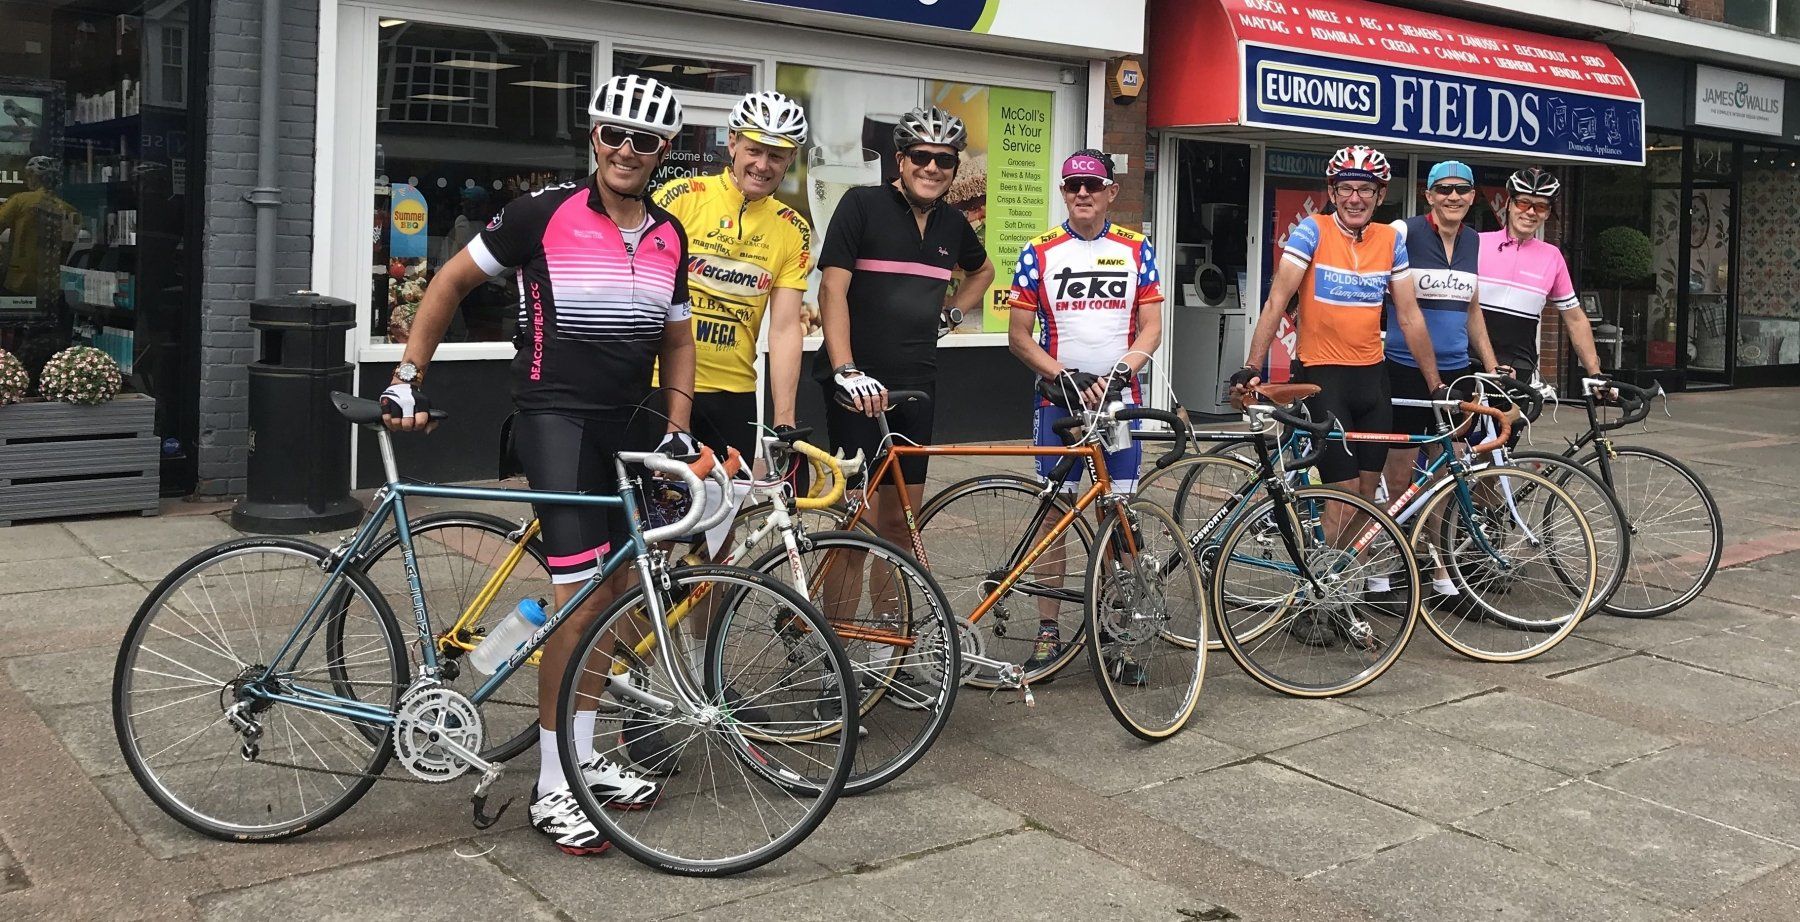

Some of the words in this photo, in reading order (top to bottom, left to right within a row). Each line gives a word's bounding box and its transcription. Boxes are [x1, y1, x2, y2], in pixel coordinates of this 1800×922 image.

[1305, 8, 1340, 24] MIELE
[1359, 17, 1383, 31] AEG
[1398, 24, 1444, 42] SIEMENS
[1458, 35, 1502, 51] ZANUSSI
[1513, 44, 1570, 63] ELECTROLUX
[1581, 55, 1606, 68] SEBO
[1239, 14, 1290, 35] MAYTAG
[1310, 27, 1364, 46] ADMIRAL
[1380, 38, 1419, 54] CREDA
[1434, 47, 1480, 64] CANNON
[1493, 57, 1538, 73] LIEBHERR
[1549, 66, 1584, 81] BENDIX
[1591, 72, 1627, 86] TRICITY
[1123, 73, 1138, 83] ADT
[1001, 106, 1045, 122] McColl's
[1266, 73, 1371, 112] EURONICS
[1391, 74, 1540, 146] FIELDS
[1004, 122, 1016, 136] At
[1018, 124, 1042, 138] Your
[1002, 138, 1042, 153] Service
[1568, 141, 1593, 152] Domestic
[1594, 144, 1623, 155] Appliances
[703, 152, 714, 163] to
[1007, 158, 1036, 168] Groceries
[1071, 160, 1096, 171] BCC
[1001, 170, 1018, 179] News
[1025, 172, 1041, 181] Mags
[657, 182, 690, 208] catone
[688, 179, 706, 192] Uno
[1000, 183, 1018, 191] Beers
[1024, 185, 1043, 193] Wines
[997, 195, 1015, 204] Crisps
[1023, 196, 1044, 205] Snacks
[394, 211, 425, 222] Summer
[1008, 209, 1033, 217] Tobacco
[400, 221, 419, 229] BBQ
[1005, 221, 1016, 229] Soft
[1017, 222, 1036, 230] Drinks
[998, 245, 1018, 254] Mobile
[1097, 258, 1125, 266] MAVIC
[688, 255, 758, 288] Mercatone
[1418, 274, 1474, 294] Carlton
[1056, 301, 1069, 311] EN
[1071, 301, 1086, 311] SU
[1088, 300, 1127, 311] COCINA
[530, 281, 545, 381] BEACONSFIELD.CC
[696, 319, 736, 347] WEGA
